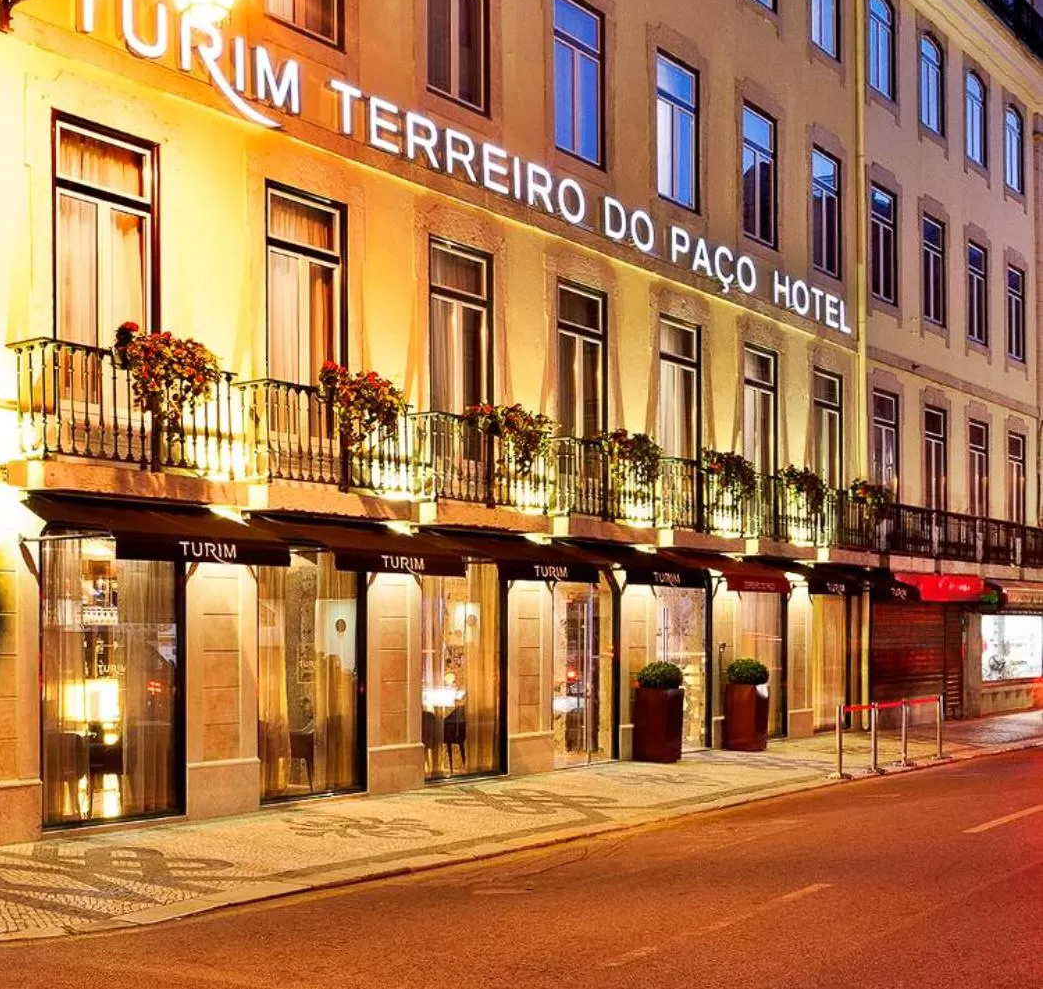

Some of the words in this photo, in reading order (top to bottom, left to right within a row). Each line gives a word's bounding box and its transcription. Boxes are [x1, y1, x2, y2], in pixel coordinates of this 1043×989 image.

[330, 77, 586, 225] TERREIRO
[603, 195, 655, 253] DO
[670, 225, 757, 295] PAÇO
[773, 269, 852, 335] HOTEL
[179, 540, 237, 565] TURIM
[381, 554, 426, 576] TURIM
[533, 565, 569, 581] TURIM
[653, 571, 681, 587] TURIM
